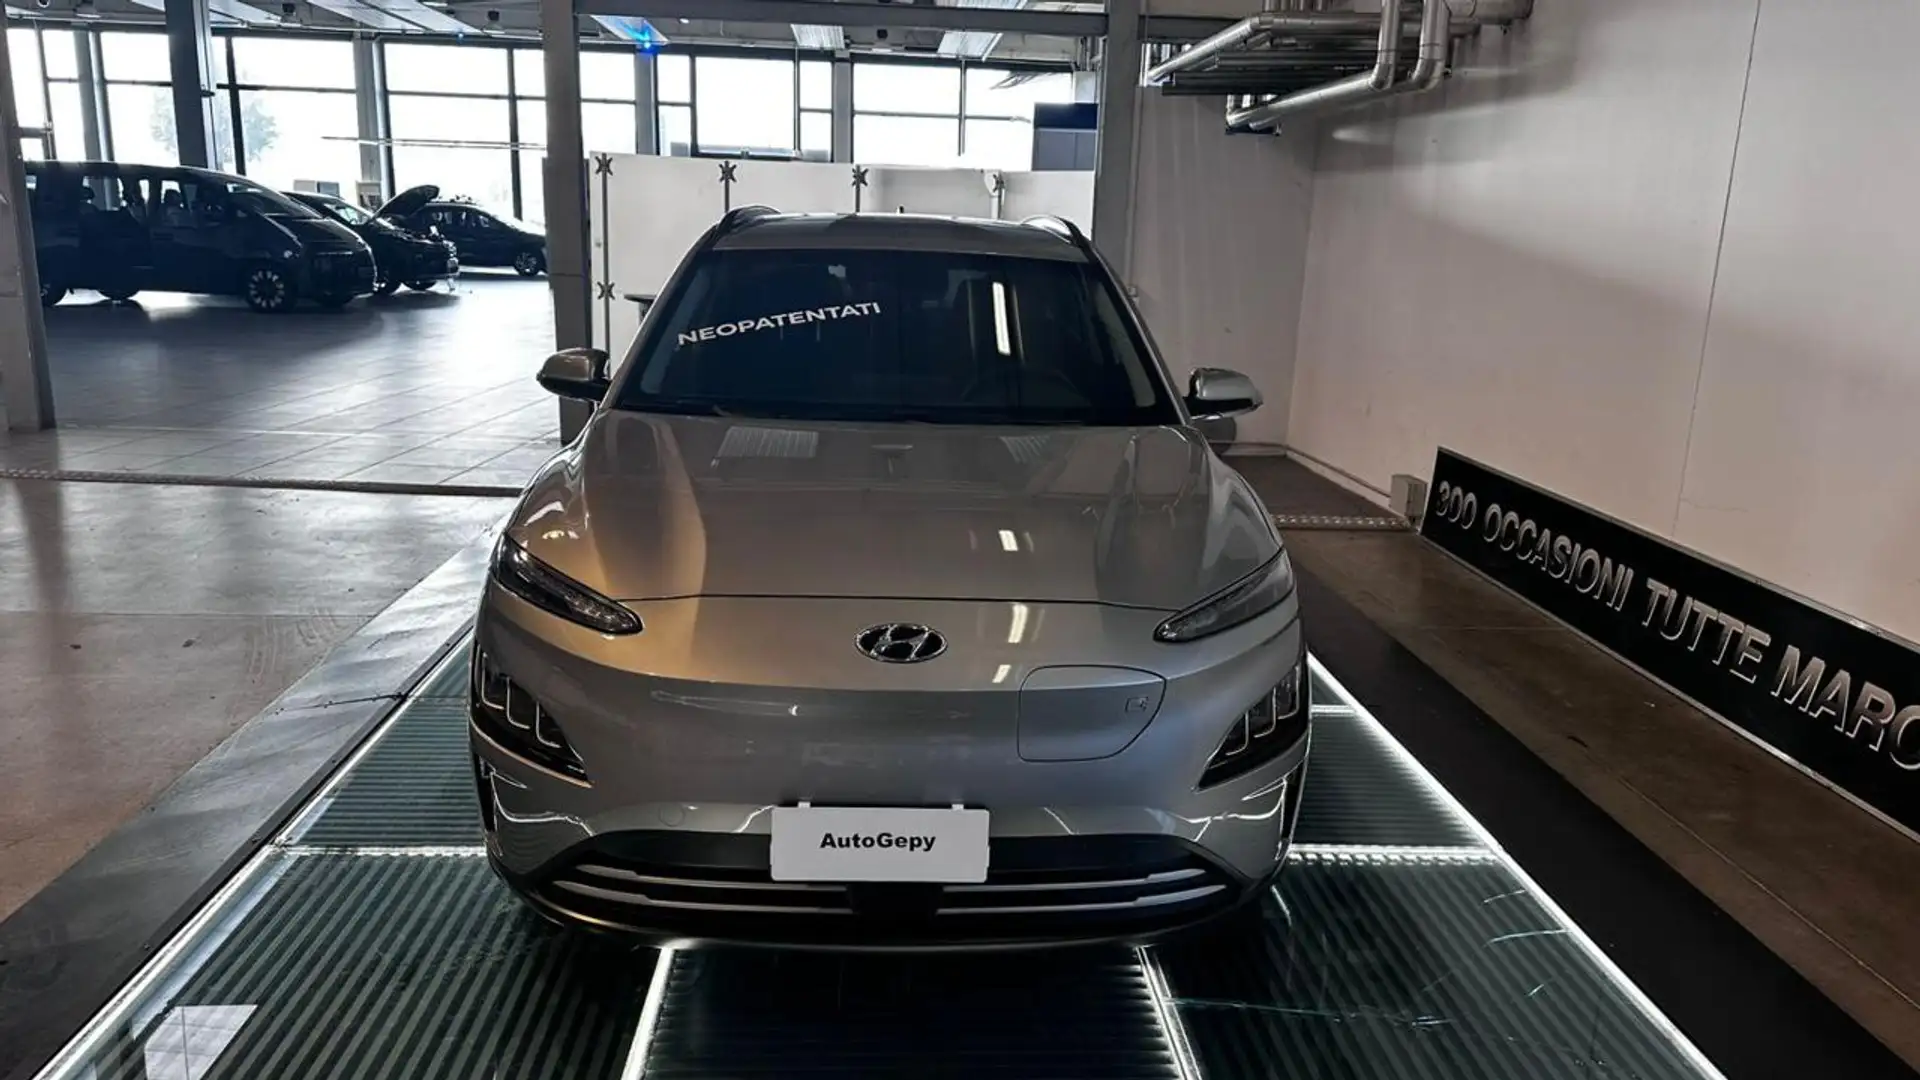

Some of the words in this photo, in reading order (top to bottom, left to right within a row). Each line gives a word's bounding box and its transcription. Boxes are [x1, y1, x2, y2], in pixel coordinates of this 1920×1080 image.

[677, 302, 881, 346] NEOPATENTATI
[1436, 480, 1478, 530] 300
[1483, 504, 1634, 612] OCCASIONI
[1642, 578, 1771, 683] TUTTE
[821, 832, 936, 852] AutoGepy
